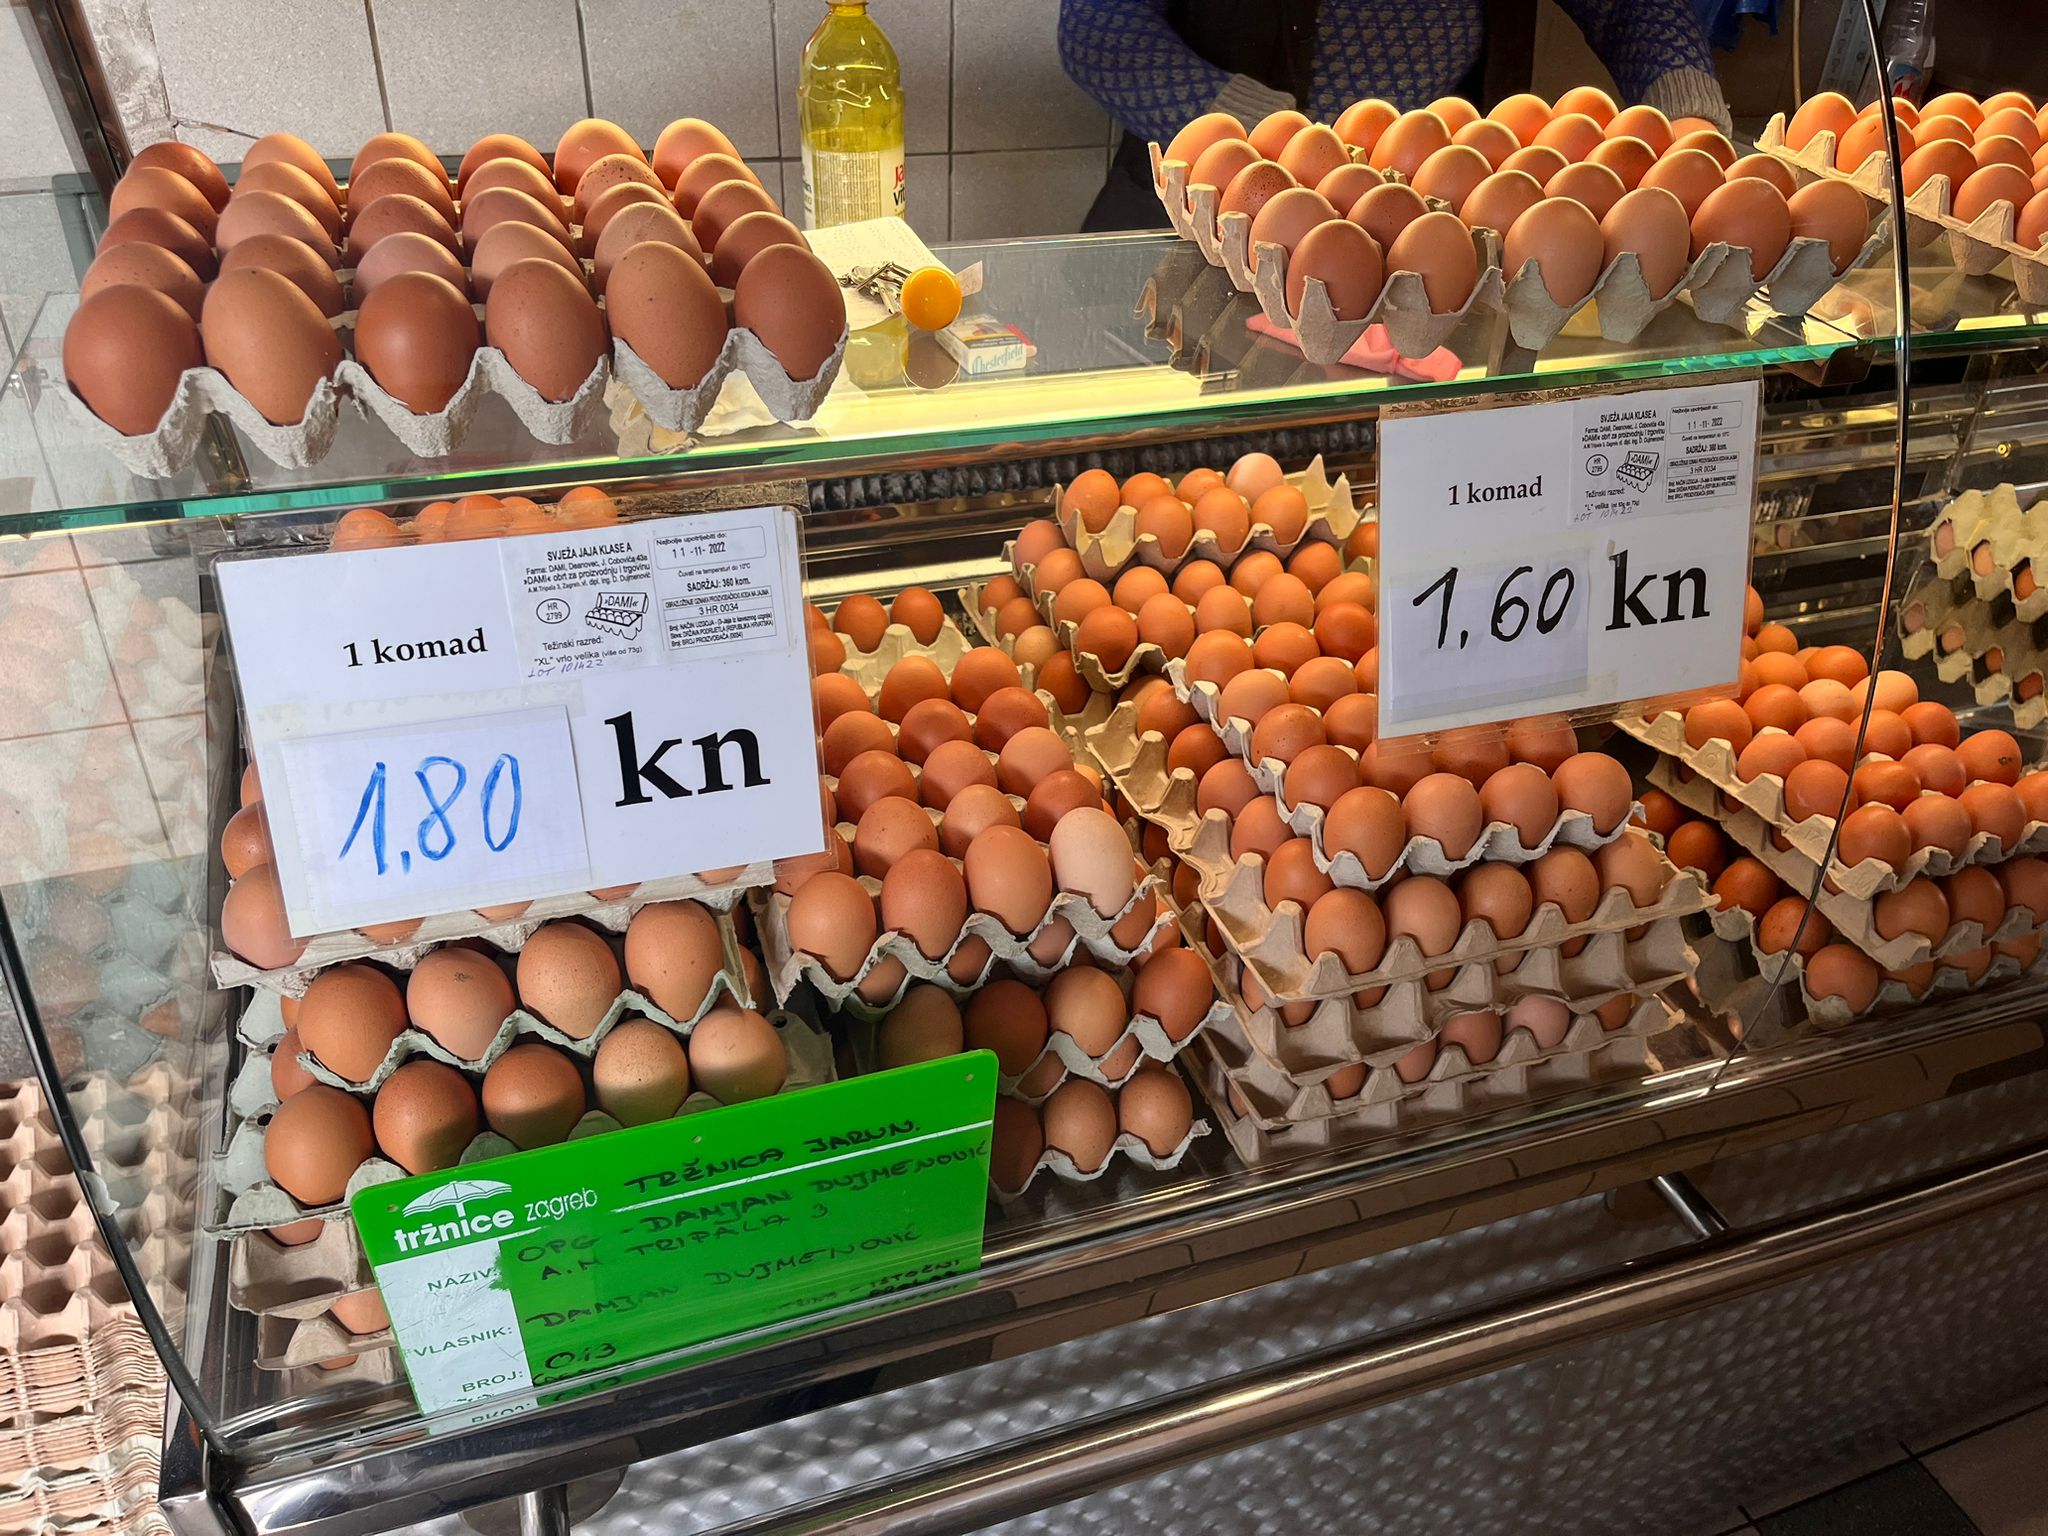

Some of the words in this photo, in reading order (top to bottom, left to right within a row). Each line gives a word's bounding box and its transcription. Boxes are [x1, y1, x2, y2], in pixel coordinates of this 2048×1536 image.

[1600, 411, 1620, 423] SVJEŽA
[1621, 412, 1633, 420] JAJA
[1635, 410, 1652, 419] KLASE
[1653, 410, 1656, 418] A
[1712, 417, 1723, 426] 2022
[1448, 484, 1460, 506] 1
[1467, 476, 1543, 504] komad
[547, 546, 577, 561] SVJEŽA
[579, 546, 598, 557] JAJA
[599, 543, 624, 555] KLASE
[626, 542, 632, 552] A
[656, 538, 682, 546] Najbolje
[709, 542, 726, 554] 2022
[526, 567, 547, 575] Farma:
[549, 564, 567, 573] DAMI,
[553, 572, 567, 581] obrt
[579, 567, 617, 579] proizvodnju
[623, 563, 650, 574] trgovinu
[687, 579, 721, 592] SADRŽAJ:
[722, 578, 733, 588] 360
[735, 577, 751, 585] kom.
[1605, 550, 1710, 631] kn
[547, 602, 558, 610] HR
[699, 607, 704, 615] 3
[706, 605, 718, 614] HR
[720, 603, 738, 612] 0034
[546, 612, 562, 621] 2799
[343, 641, 363, 668] 1
[371, 628, 488, 666] komad
[542, 641, 574, 651] Težinski
[576, 636, 603, 646] razred:
[534, 656, 553, 666] "XL"
[556, 654, 572, 663] vrlo
[574, 651, 600, 661] velika
[602, 649, 617, 658] (više
[627, 646, 642, 655] 73g)
[604, 711, 770, 808] kn
[624, 1148, 786, 1194] TRŽNICA
[394, 1209, 514, 1252] tržnice
[524, 1188, 598, 1222] zagreb
[624, 1214, 790, 1256] TRIPALA
[811, 1203, 829, 1220] 3
[518, 1236, 600, 1262] OPG
[414, 1326, 513, 1357] VLASNIK:
[462, 1370, 523, 1392] BROJ:
